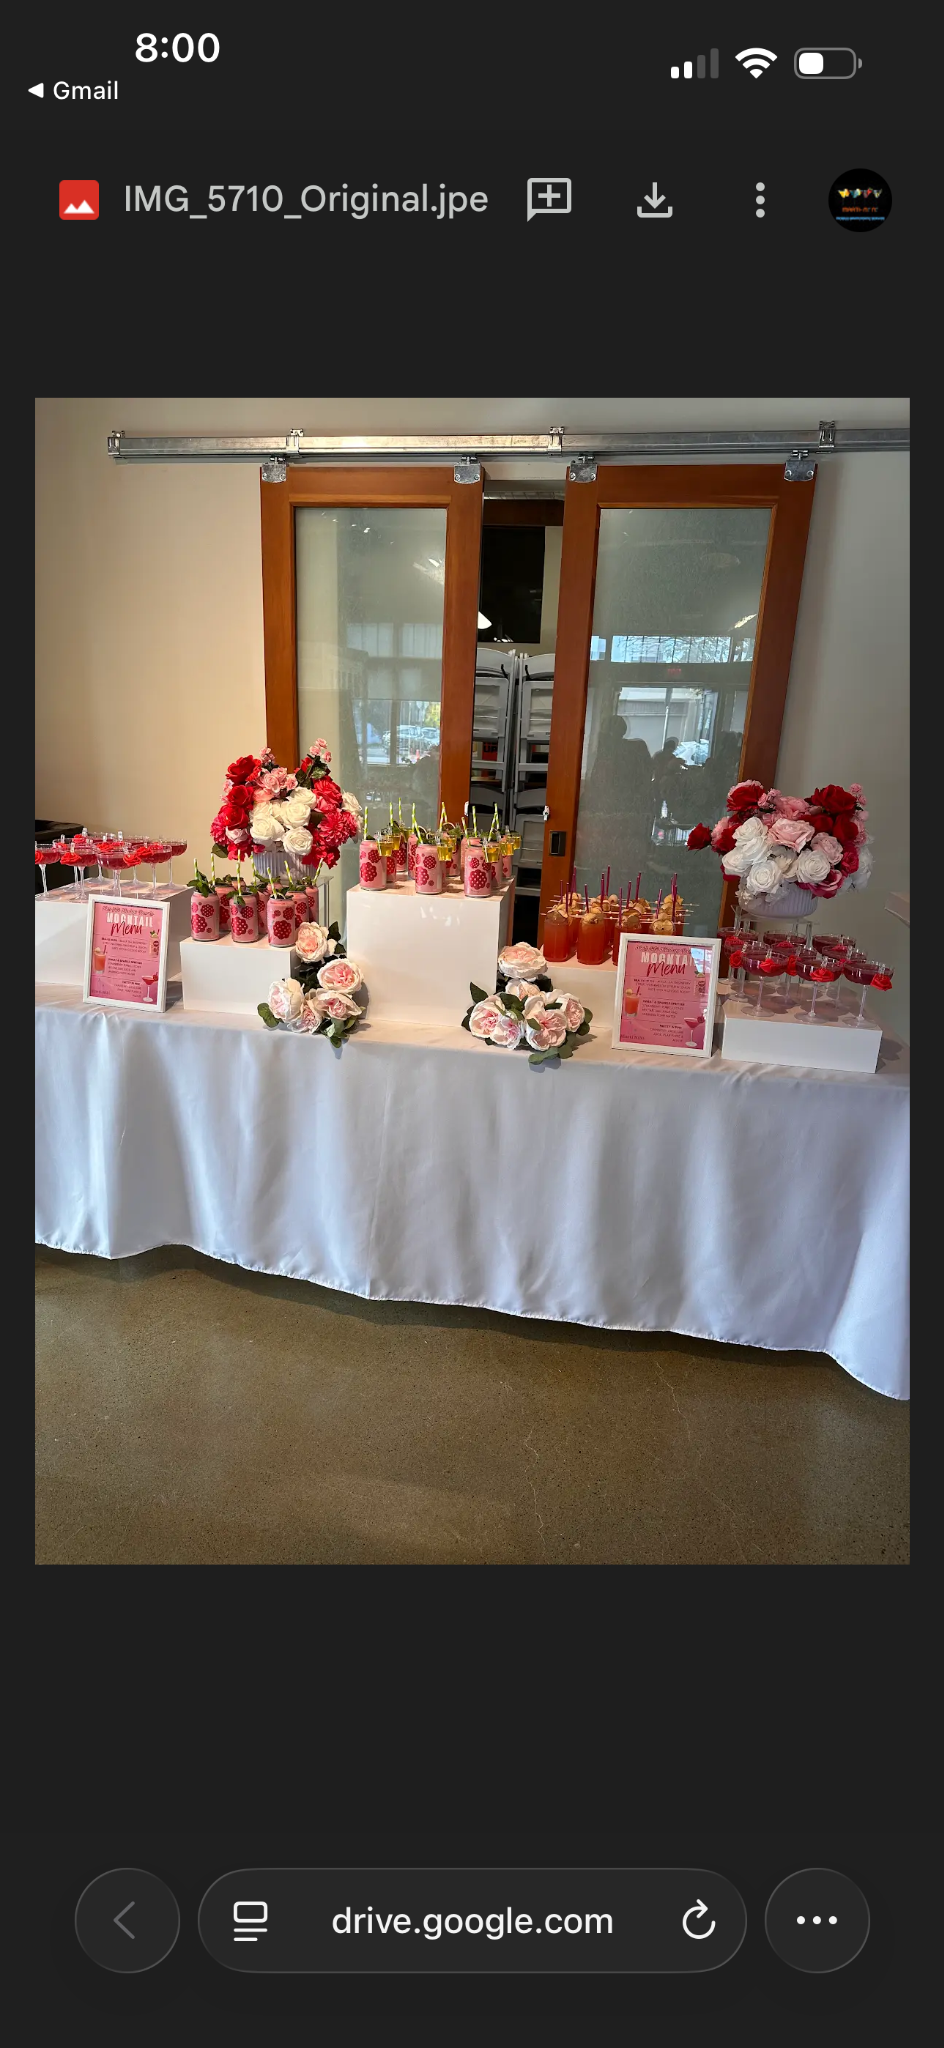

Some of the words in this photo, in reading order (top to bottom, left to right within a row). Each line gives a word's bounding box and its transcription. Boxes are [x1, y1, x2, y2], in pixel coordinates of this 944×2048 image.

[135, 33, 221, 63] 8:00
[53, 80, 119, 101] Gmail
[125, 184, 489, 220] IMG_5710_Original.jpe
[110, 921, 142, 936] Menu
[641, 952, 697, 967] MOCKTAI
[646, 961, 686, 977] Menu
[332, 1905, 614, 1941] drive.google.com
